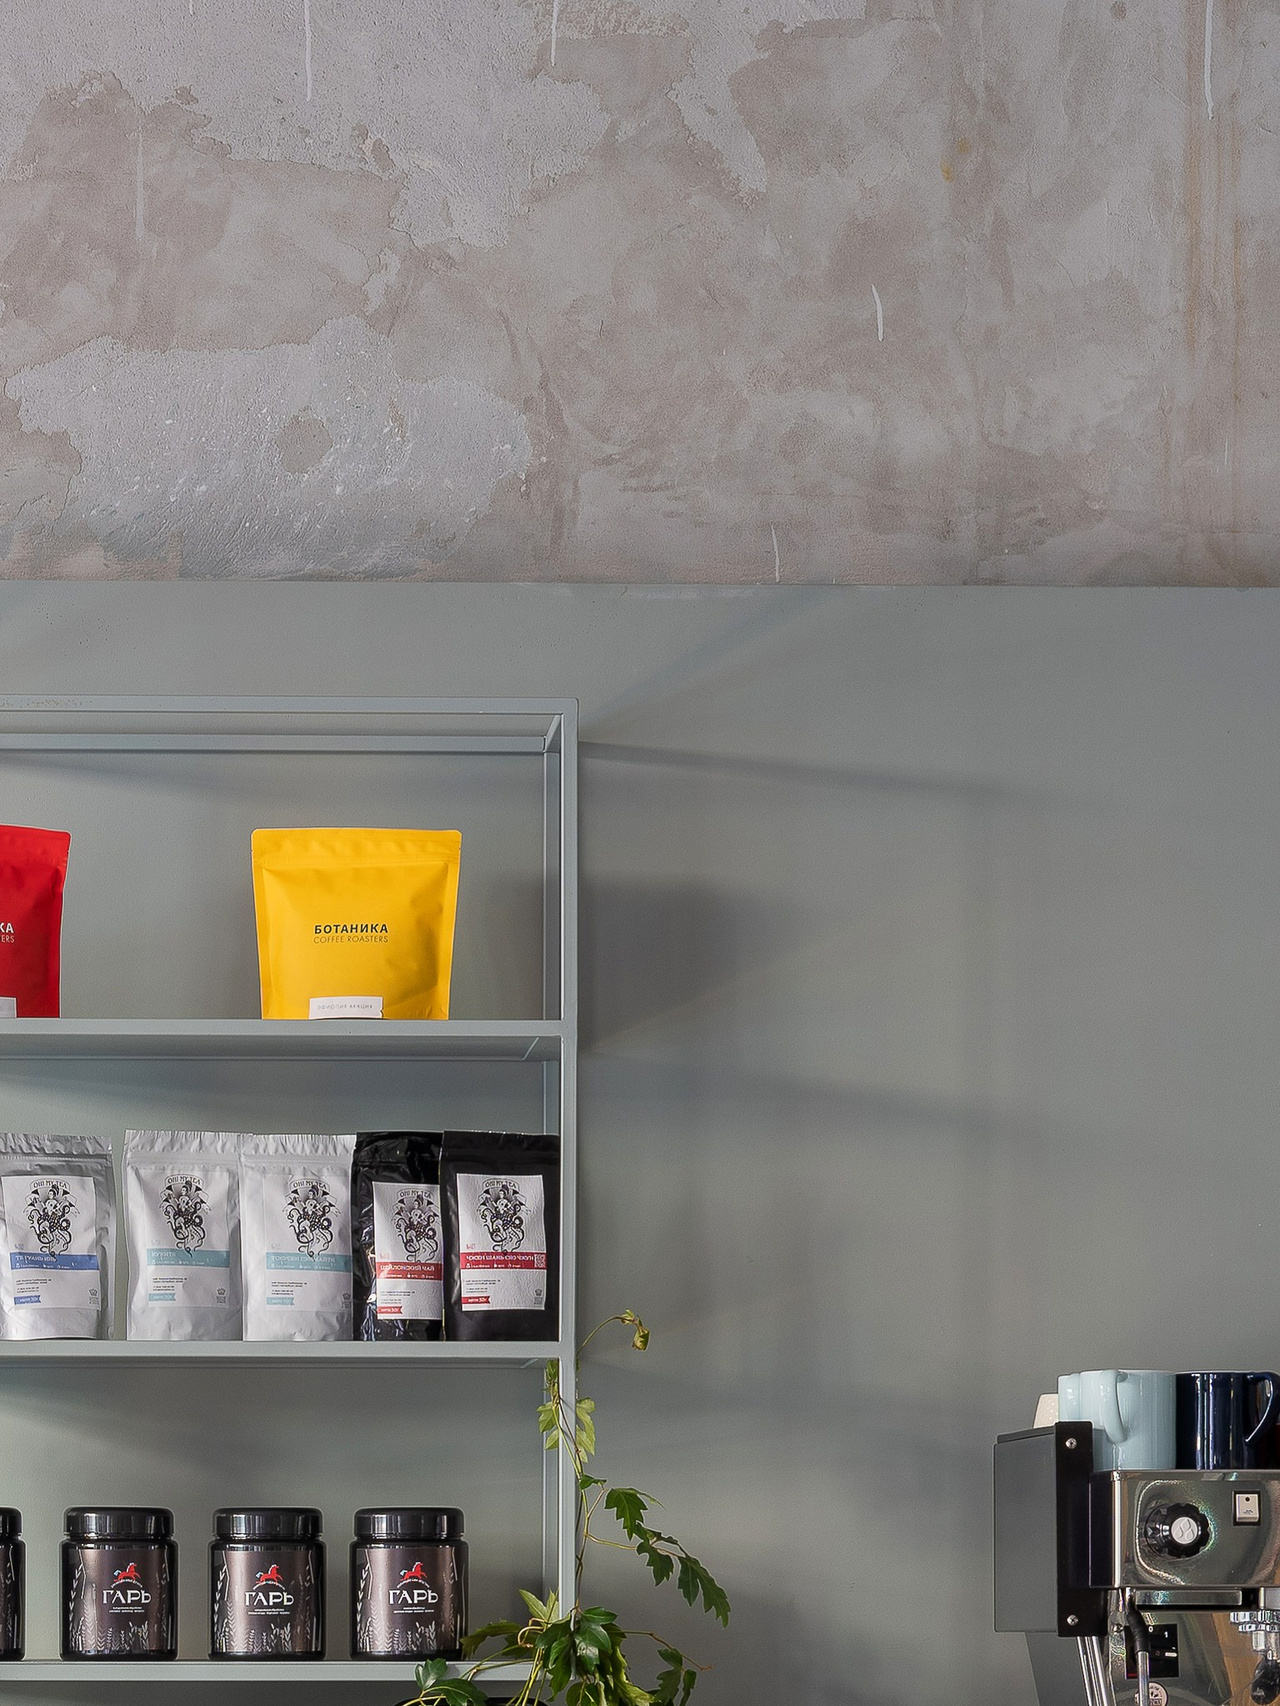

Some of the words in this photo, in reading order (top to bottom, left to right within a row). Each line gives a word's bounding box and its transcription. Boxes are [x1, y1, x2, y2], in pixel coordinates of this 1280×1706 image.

[314, 923, 389, 934] БОТАНИКА
[313, 935, 344, 944] COFFEE
[347, 935, 388, 943] ROASTERS
[102, 1589, 152, 1604] ГАРЬ
[244, 1591, 295, 1606] ГАРЬ
[388, 1589, 439, 1604] ГАРЬ
